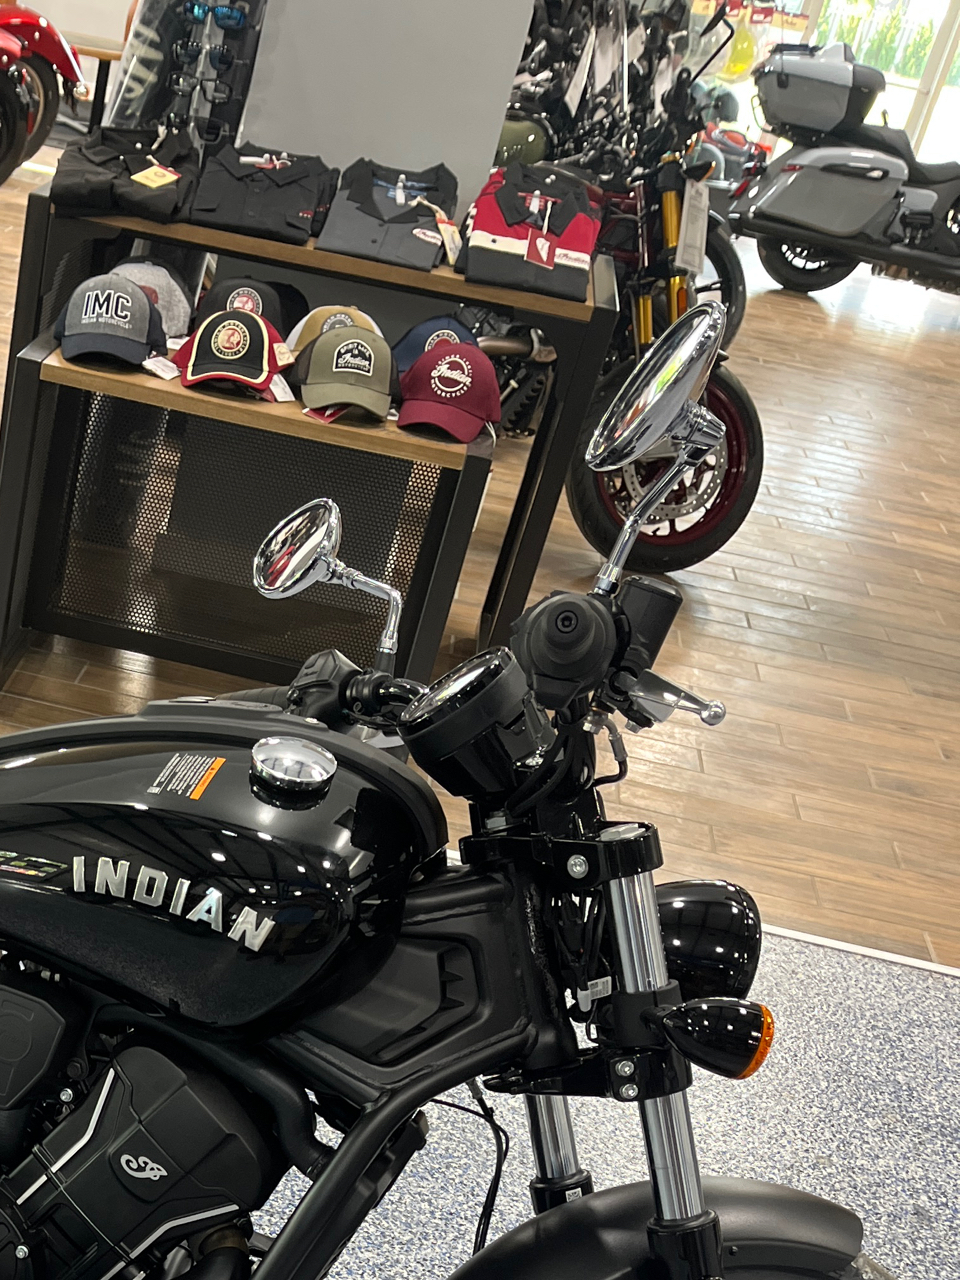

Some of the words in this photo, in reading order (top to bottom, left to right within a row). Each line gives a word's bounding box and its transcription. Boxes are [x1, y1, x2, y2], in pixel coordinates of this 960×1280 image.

[82, 290, 132, 321] IMC
[431, 364, 472, 385] Indian
[73, 855, 276, 952] INDIAN
